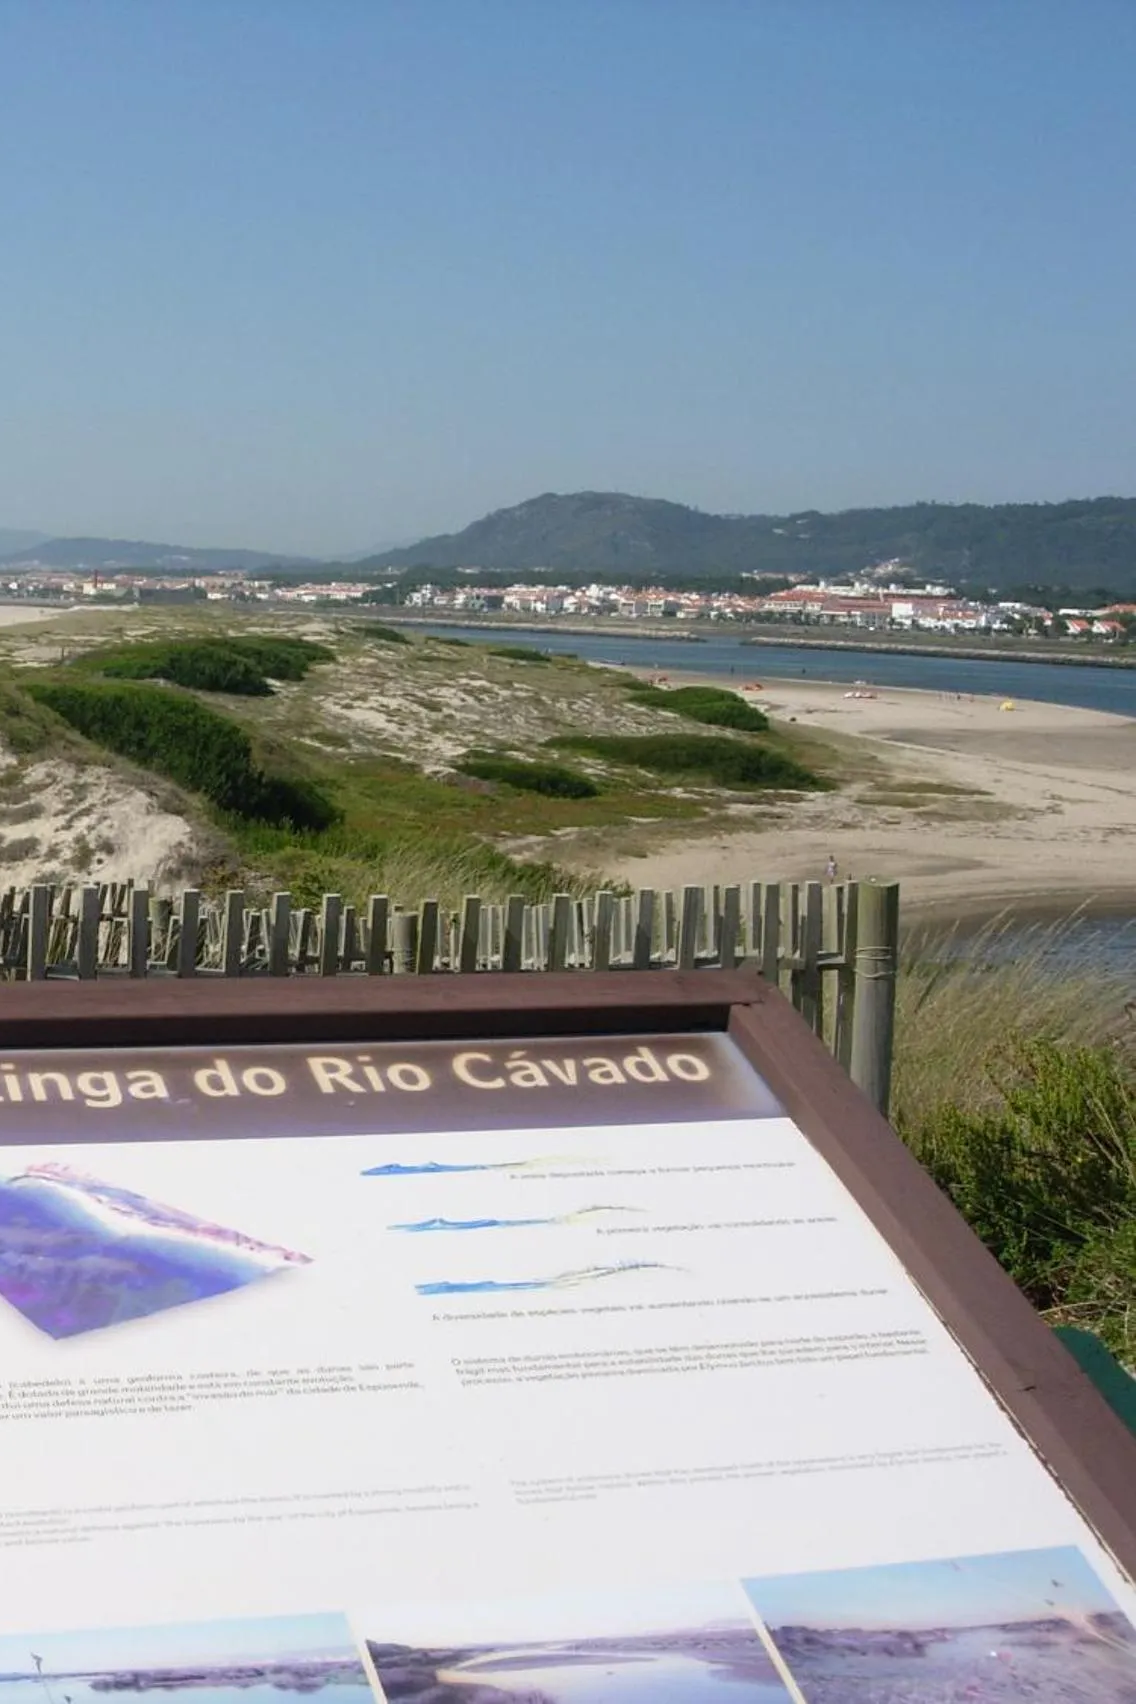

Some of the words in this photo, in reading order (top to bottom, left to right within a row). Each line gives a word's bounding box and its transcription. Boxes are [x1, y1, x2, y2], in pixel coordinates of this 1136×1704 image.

[193, 1059, 287, 1097] do
[305, 1054, 433, 1094] Rio
[451, 1046, 711, 1089] Cávado
